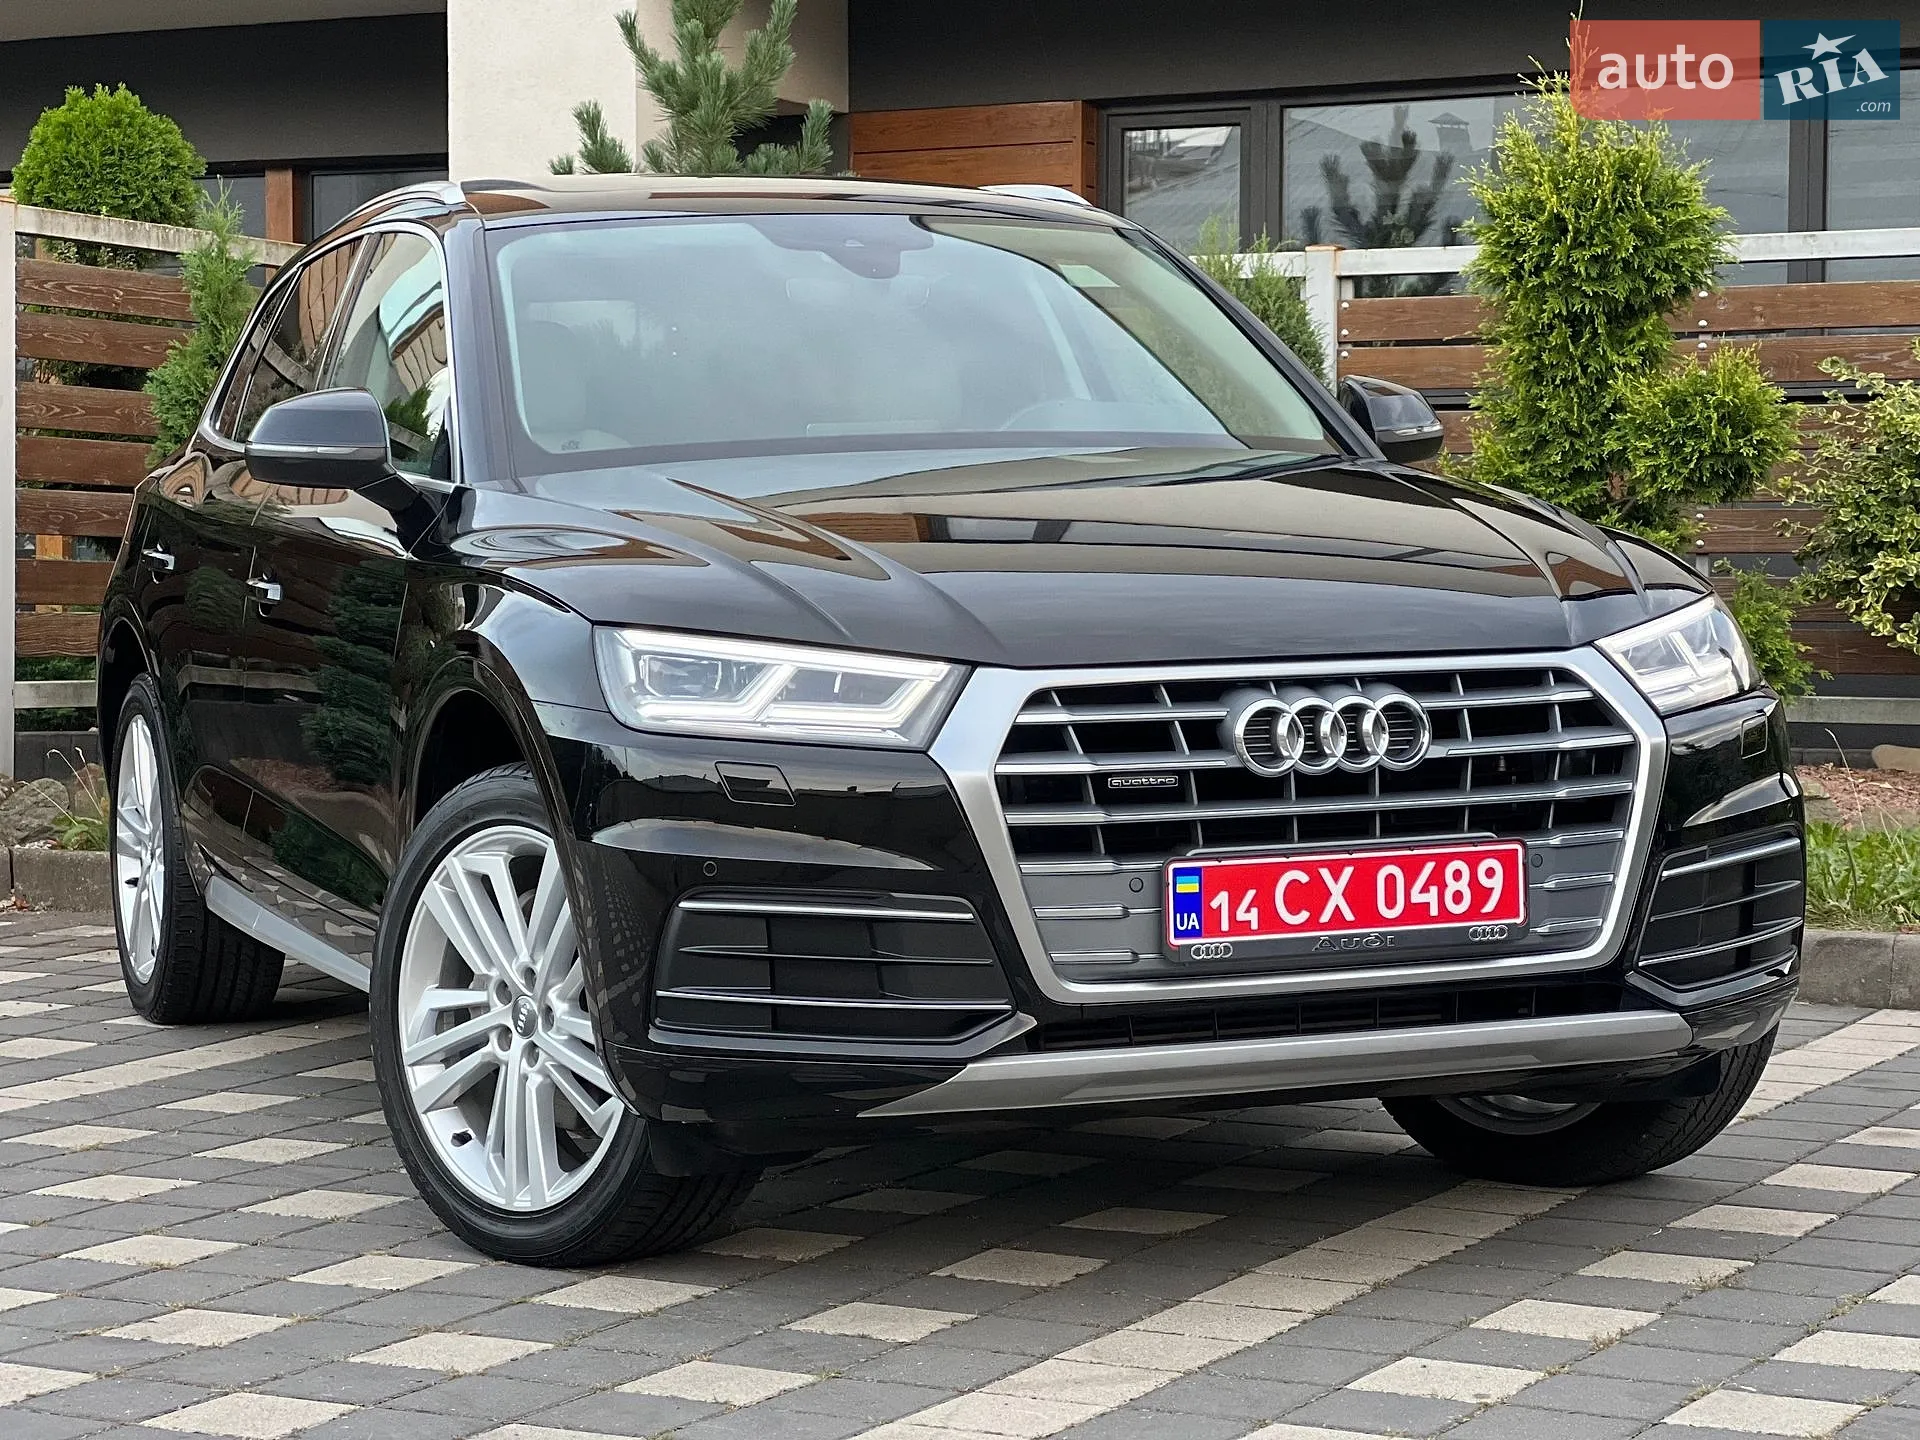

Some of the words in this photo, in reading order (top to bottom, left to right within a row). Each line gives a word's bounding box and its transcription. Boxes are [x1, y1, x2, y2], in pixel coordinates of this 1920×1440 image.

[1111, 777, 1175, 787] quattro
[1209, 888, 1259, 932] 14
[1274, 865, 1355, 926] CX
[1376, 857, 1504, 919] 0489
[1176, 911, 1200, 931] UA
